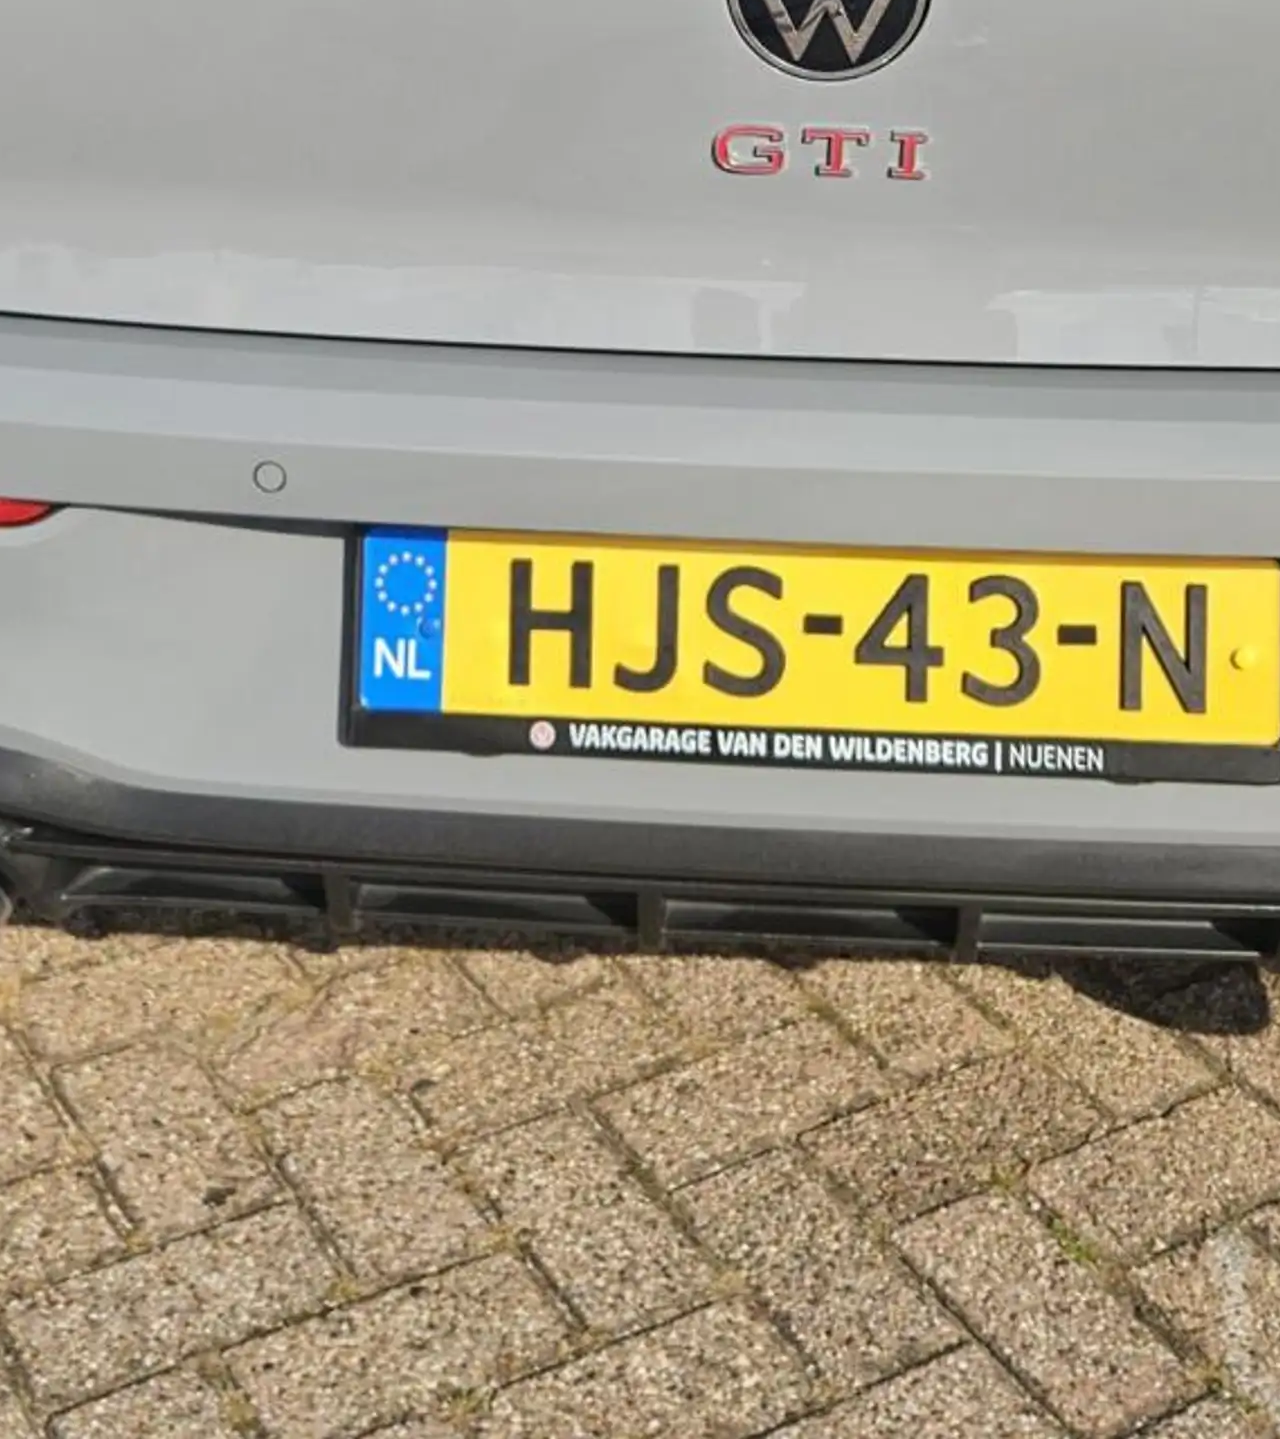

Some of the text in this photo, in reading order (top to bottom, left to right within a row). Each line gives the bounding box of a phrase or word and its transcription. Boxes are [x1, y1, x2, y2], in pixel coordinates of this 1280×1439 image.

[711, 123, 929, 181] GTI
[374, 637, 432, 679] NL
[507, 558, 1208, 715] HJS-43-N
[569, 722, 712, 755] VAKGARAGE
[717, 730, 767, 757] VAN
[773, 732, 822, 760] DEN
[829, 735, 988, 767] WILDENBERG
[1009, 743, 1104, 773] NUENEN
